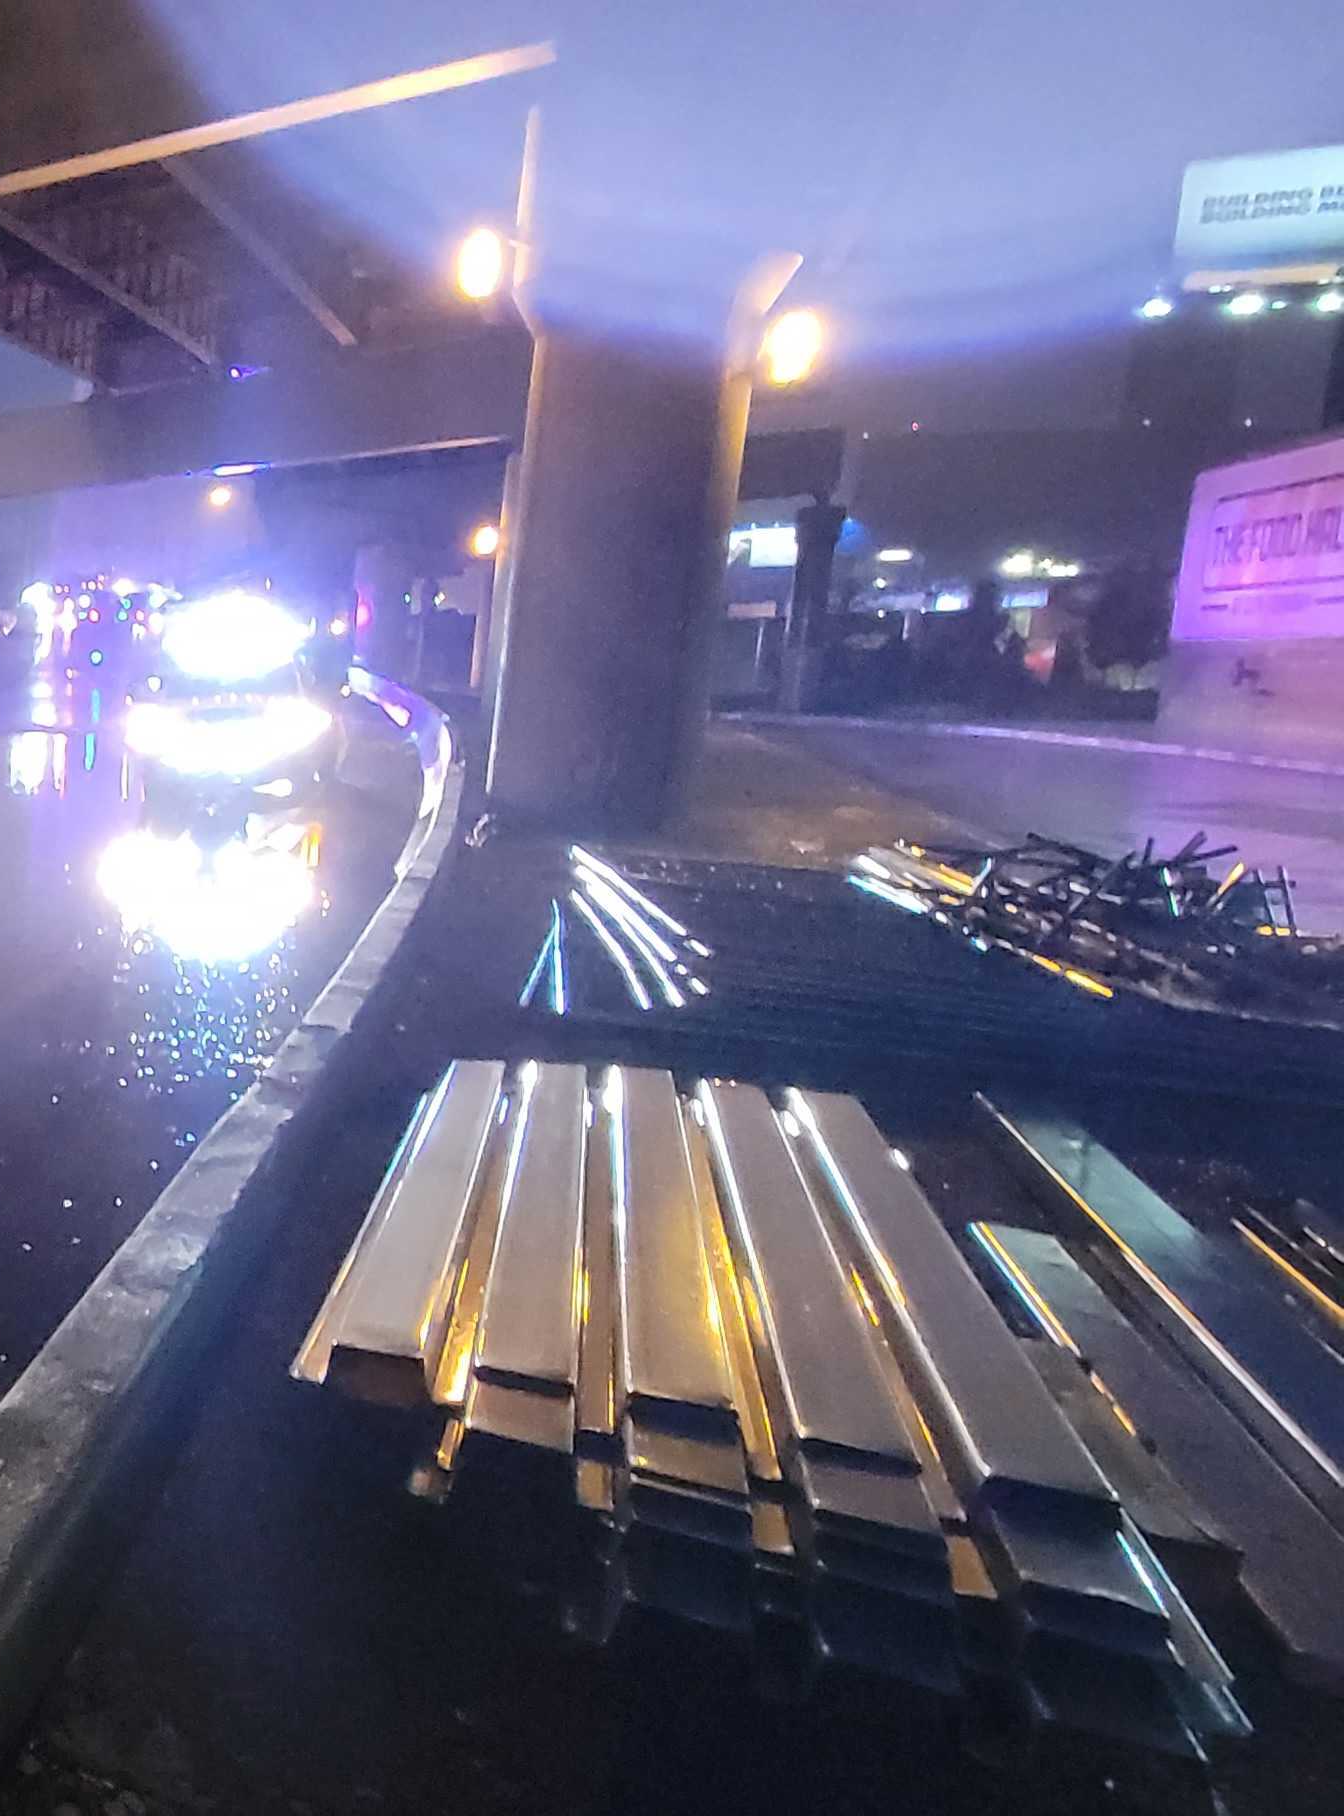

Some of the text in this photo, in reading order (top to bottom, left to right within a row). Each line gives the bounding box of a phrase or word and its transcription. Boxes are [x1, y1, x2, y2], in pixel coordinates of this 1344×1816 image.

[1203, 189, 1313, 210] BUILDING
[1200, 204, 1311, 225] BUILDING
[1213, 523, 1251, 566] THE
[1249, 513, 1303, 563] FOOD
